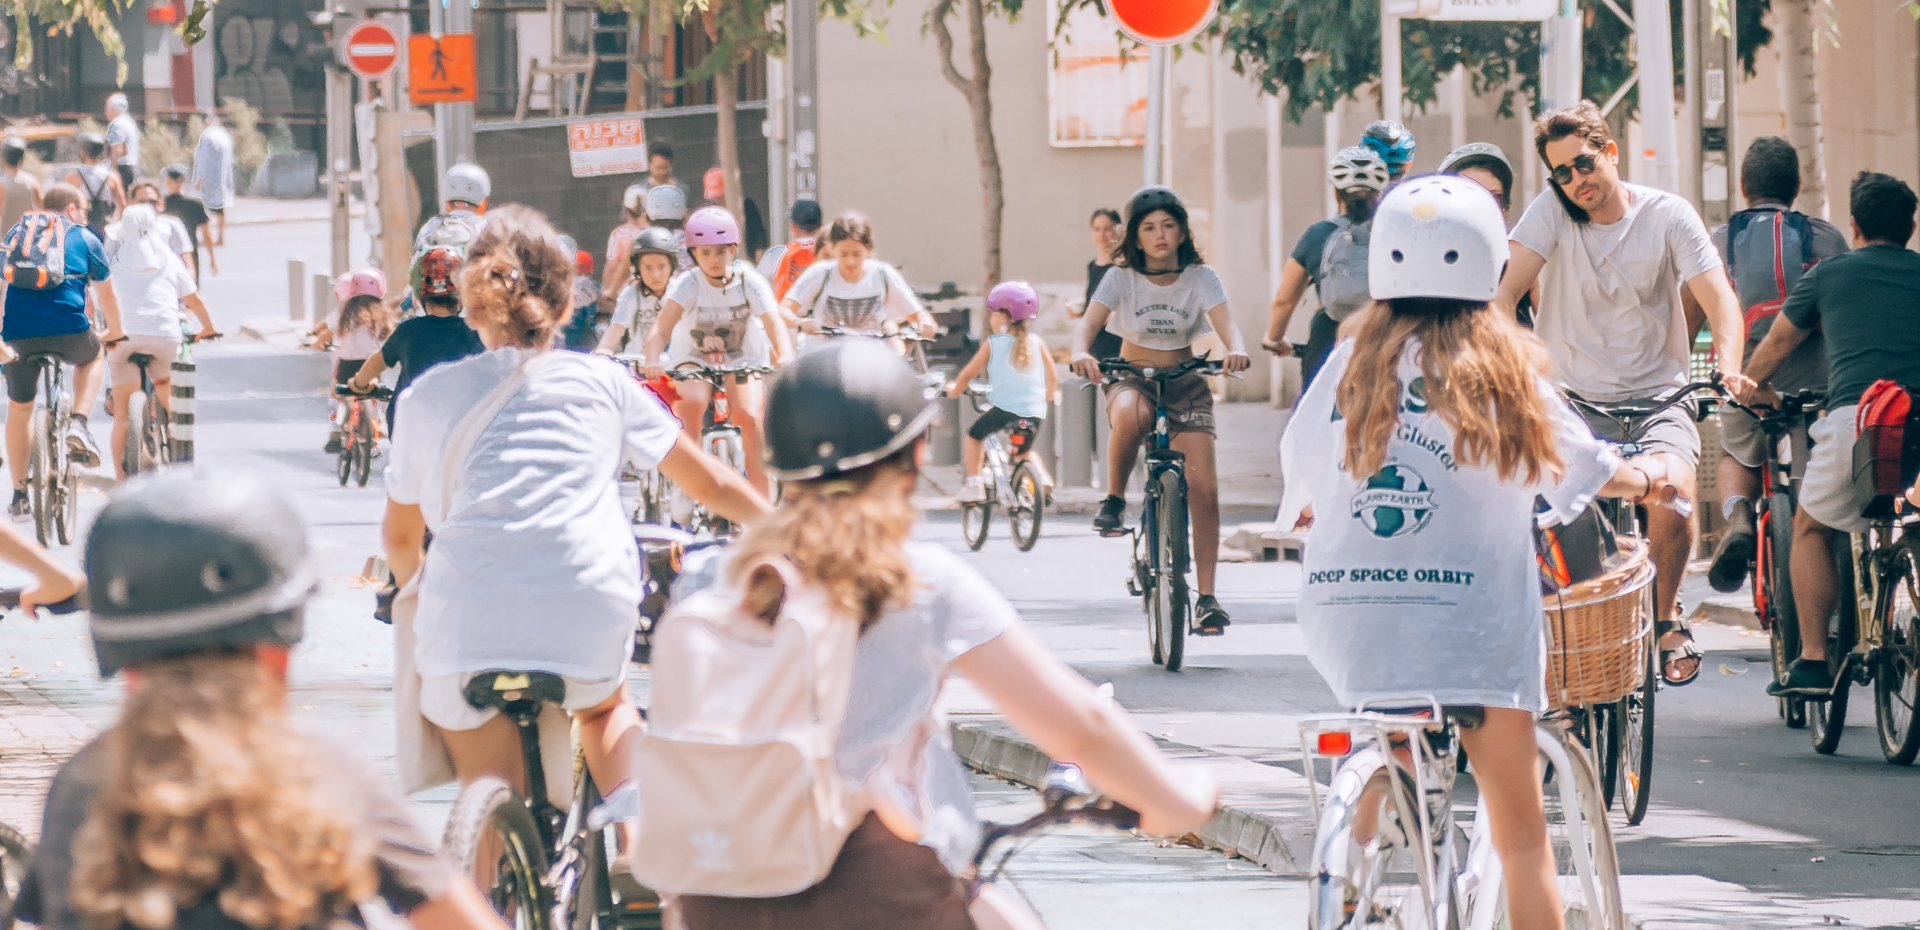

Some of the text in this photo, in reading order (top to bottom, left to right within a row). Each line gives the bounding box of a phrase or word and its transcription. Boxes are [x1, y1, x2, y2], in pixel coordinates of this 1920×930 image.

[574, 121, 637, 139] סכנה
[1135, 304, 1190, 320] BETTER LATE
[1353, 494, 1424, 508] PLANET EARTH
[1414, 568, 1475, 586] ORBIT
